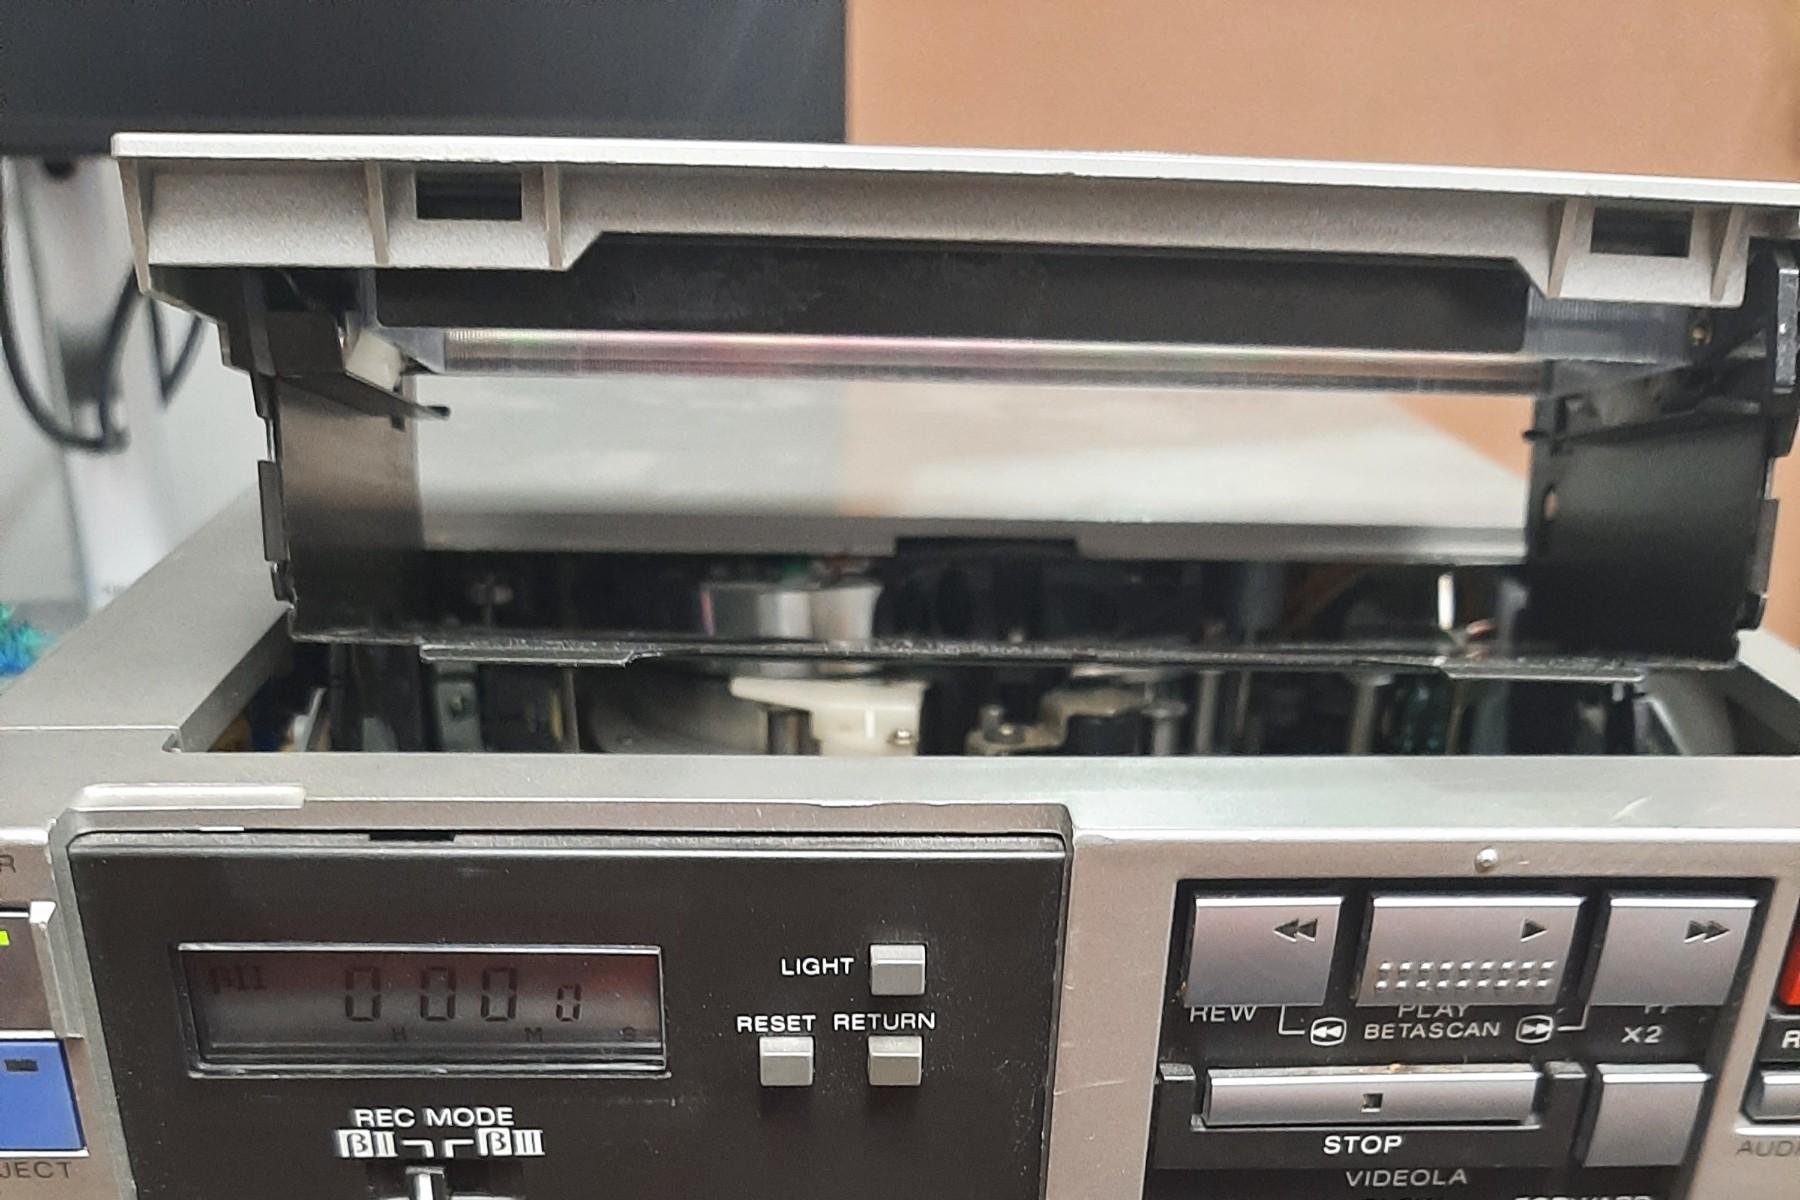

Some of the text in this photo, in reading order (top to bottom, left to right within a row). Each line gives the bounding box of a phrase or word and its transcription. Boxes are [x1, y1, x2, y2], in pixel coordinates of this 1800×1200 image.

[781, 957, 855, 976] LIGHT
[736, 1012, 937, 1033] RESET RETURN
[1364, 1021, 1501, 1040] BETASCAN
[1620, 1025, 1663, 1044] X2
[353, 1106, 515, 1128] REC MODE
[1322, 1135, 1403, 1155] STOP
[1345, 1169, 1468, 1187] VIDEOLA
